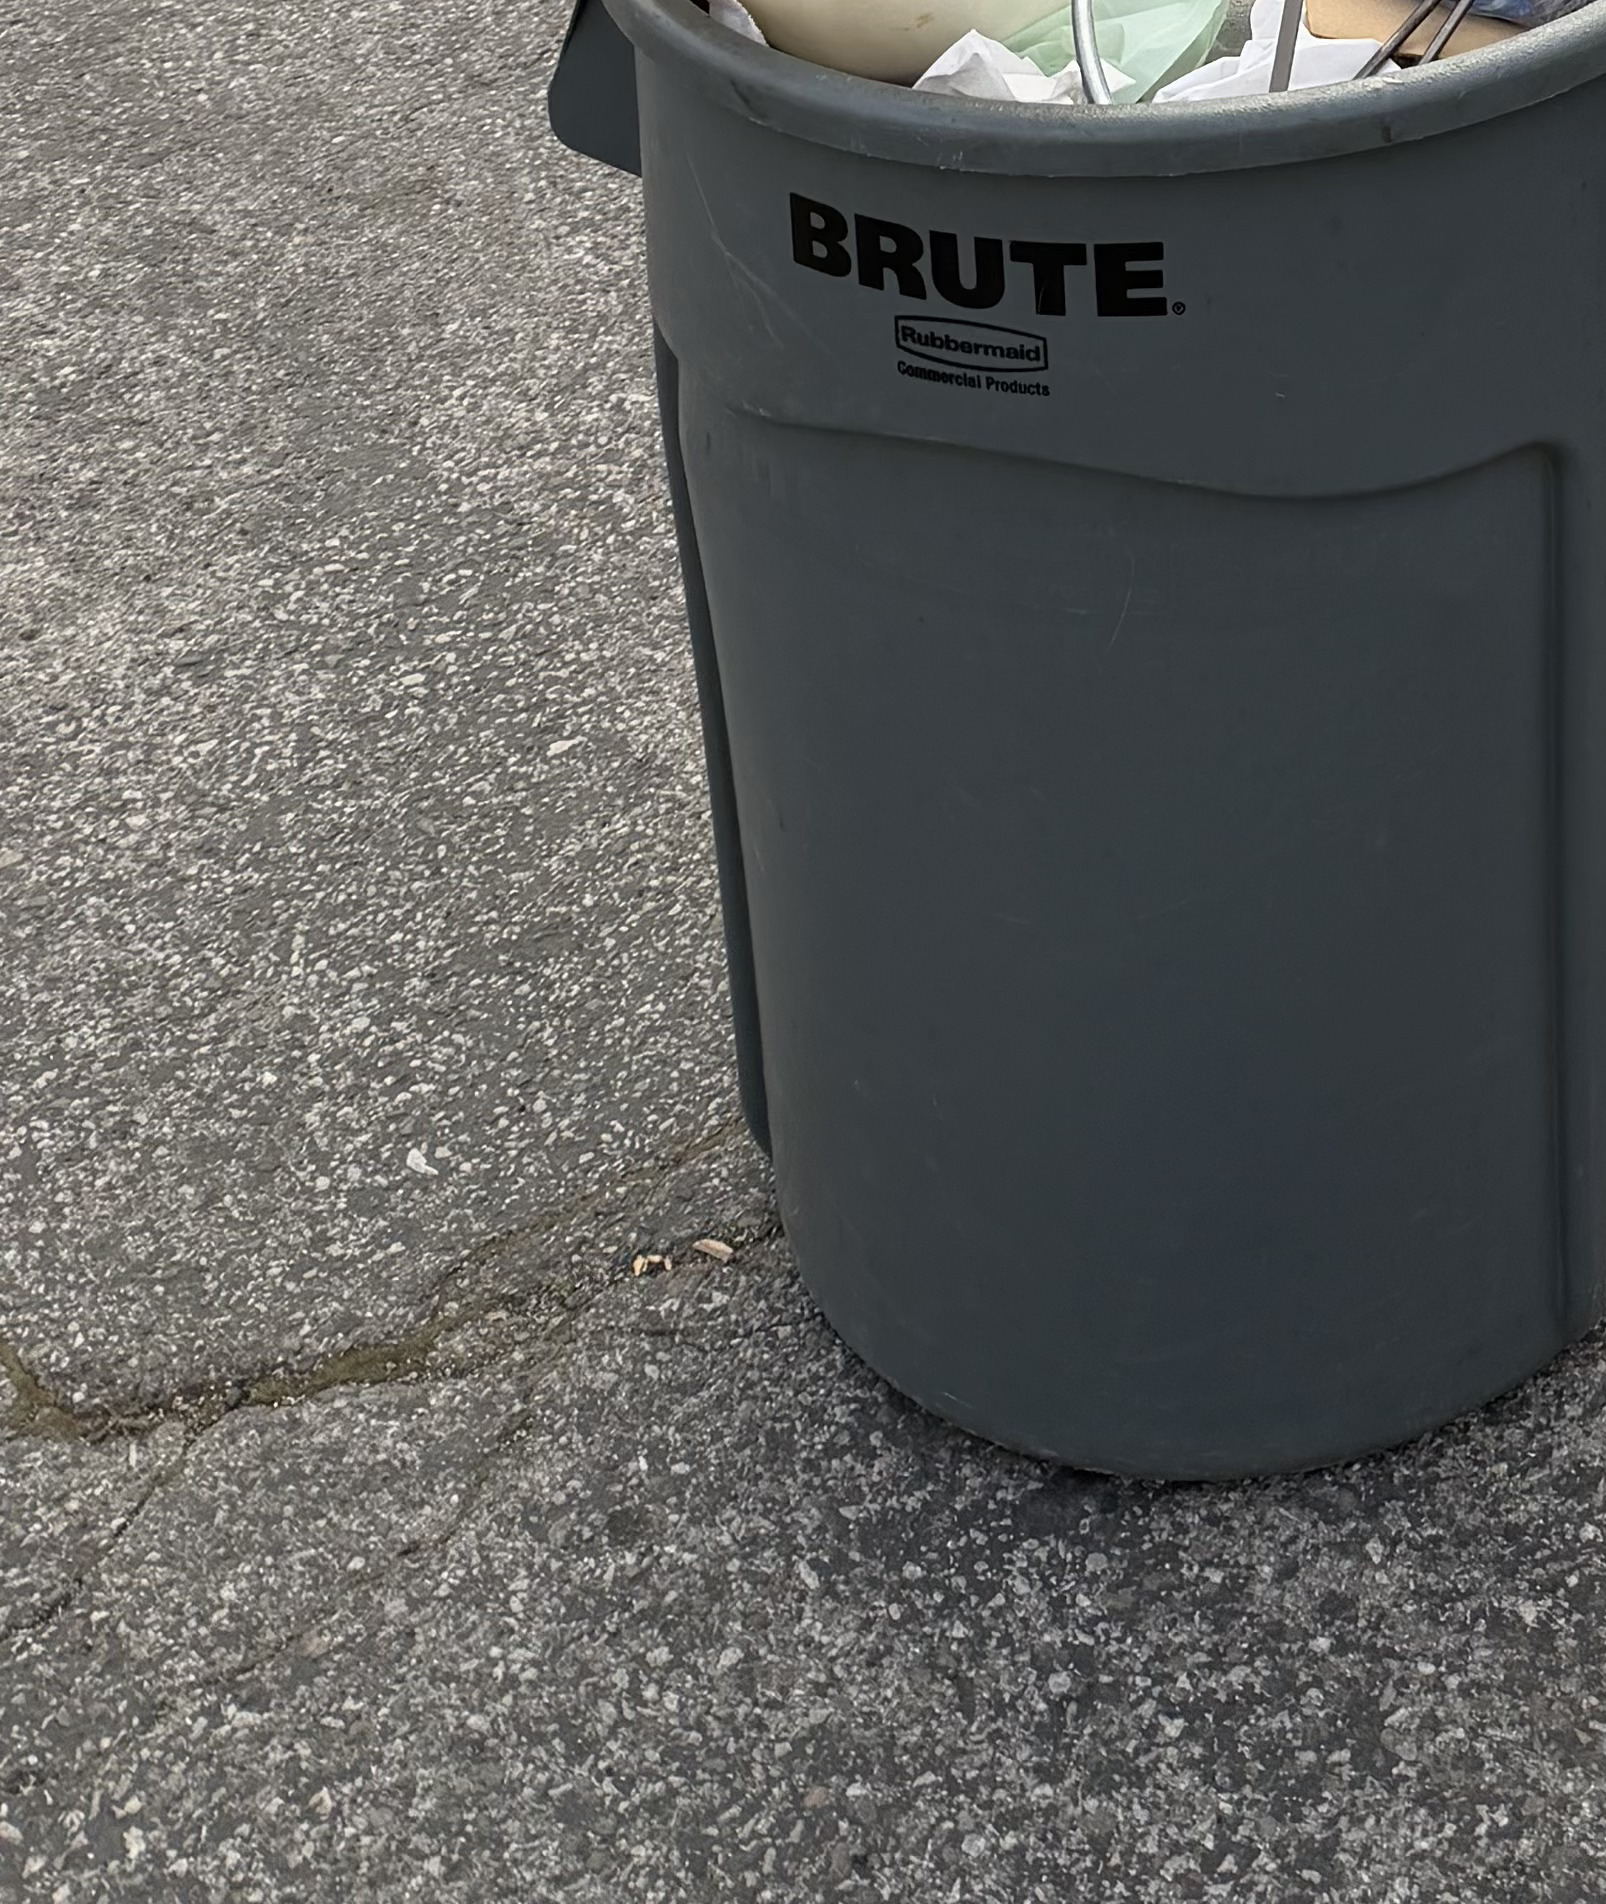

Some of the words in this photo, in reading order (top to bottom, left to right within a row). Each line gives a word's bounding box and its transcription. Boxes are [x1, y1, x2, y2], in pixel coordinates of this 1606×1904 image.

[901, 325, 1041, 362] Rubbermaid
[897, 360, 981, 389] Commercial
[985, 375, 1050, 396] Products
